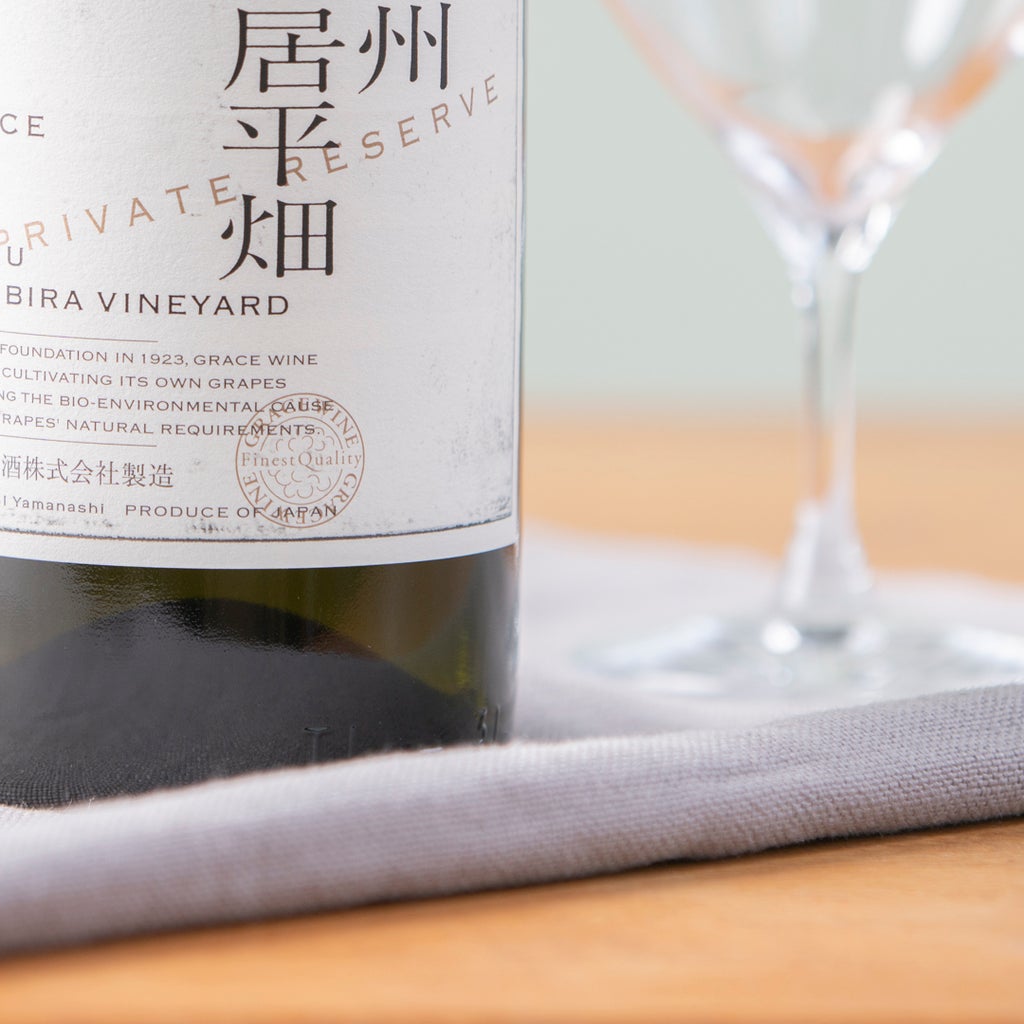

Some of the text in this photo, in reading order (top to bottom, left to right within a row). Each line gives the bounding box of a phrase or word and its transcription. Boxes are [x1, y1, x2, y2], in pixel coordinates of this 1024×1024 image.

[283, 73, 499, 186] RESERVE
[97, 290, 290, 316] VINEYARD
[0, 343, 108, 363] FOUNDATION
[115, 352, 135, 364] IN
[141, 353, 190, 368] 1923,
[193, 354, 261, 366] GRACE
[267, 353, 319, 366] WINE
[1, 367, 113, 387] CULTIVATING
[119, 375, 149, 388] ITS
[155, 377, 202, 389] OWN
[208, 378, 287, 390] GRAPES
[21, 392, 53, 406] THE
[59, 395, 264, 413] BIO-ENVIRONMENTAL
[270, 400, 335, 412] CAUSE
[67, 419, 154, 435] NATURAL
[12, 496, 105, 515] Yamanashi
[125, 504, 229, 519] PRODUCE
[236, 507, 265, 518] OF
[275, 506, 337, 518] JAPAN
